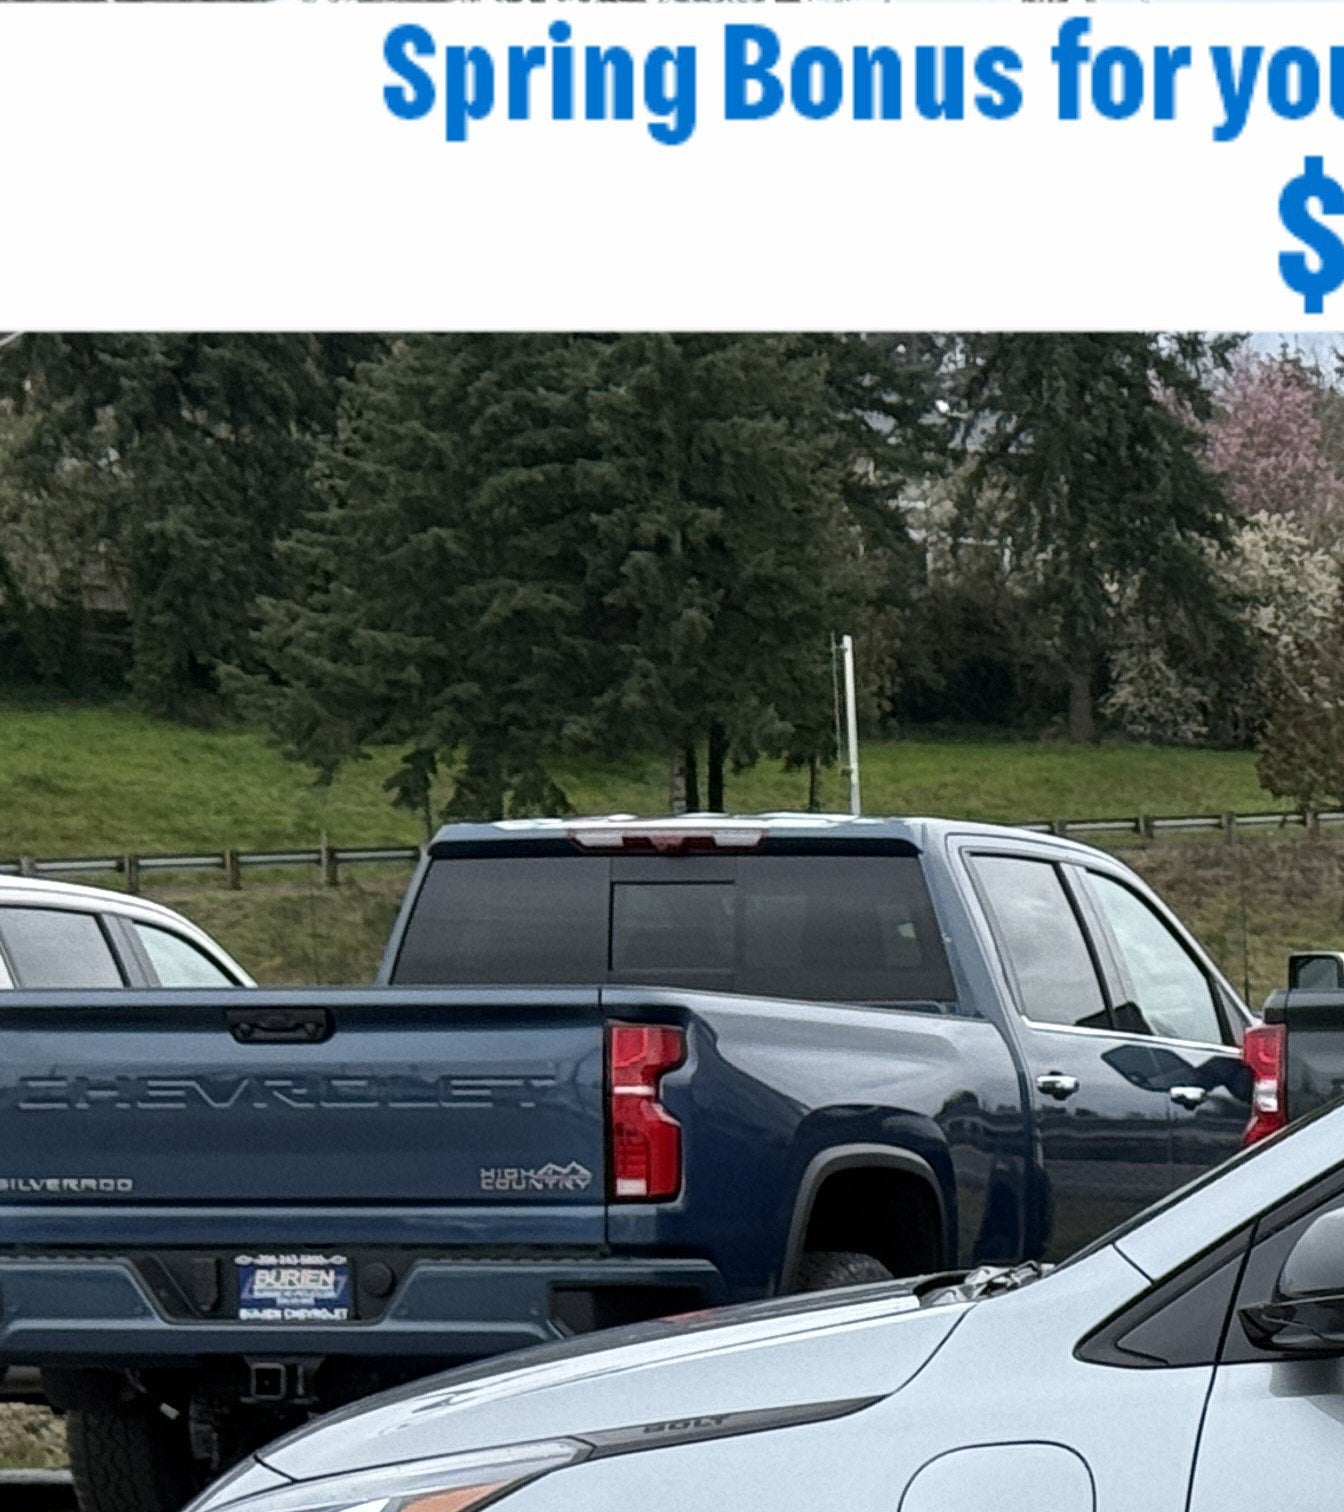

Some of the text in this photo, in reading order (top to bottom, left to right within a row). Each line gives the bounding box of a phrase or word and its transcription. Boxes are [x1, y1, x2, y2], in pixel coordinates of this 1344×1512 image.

[17, 1074, 556, 1110] CHEVROLET
[480, 1177, 593, 1191] COUNTRY
[254, 1268, 336, 1289] BURIEN
